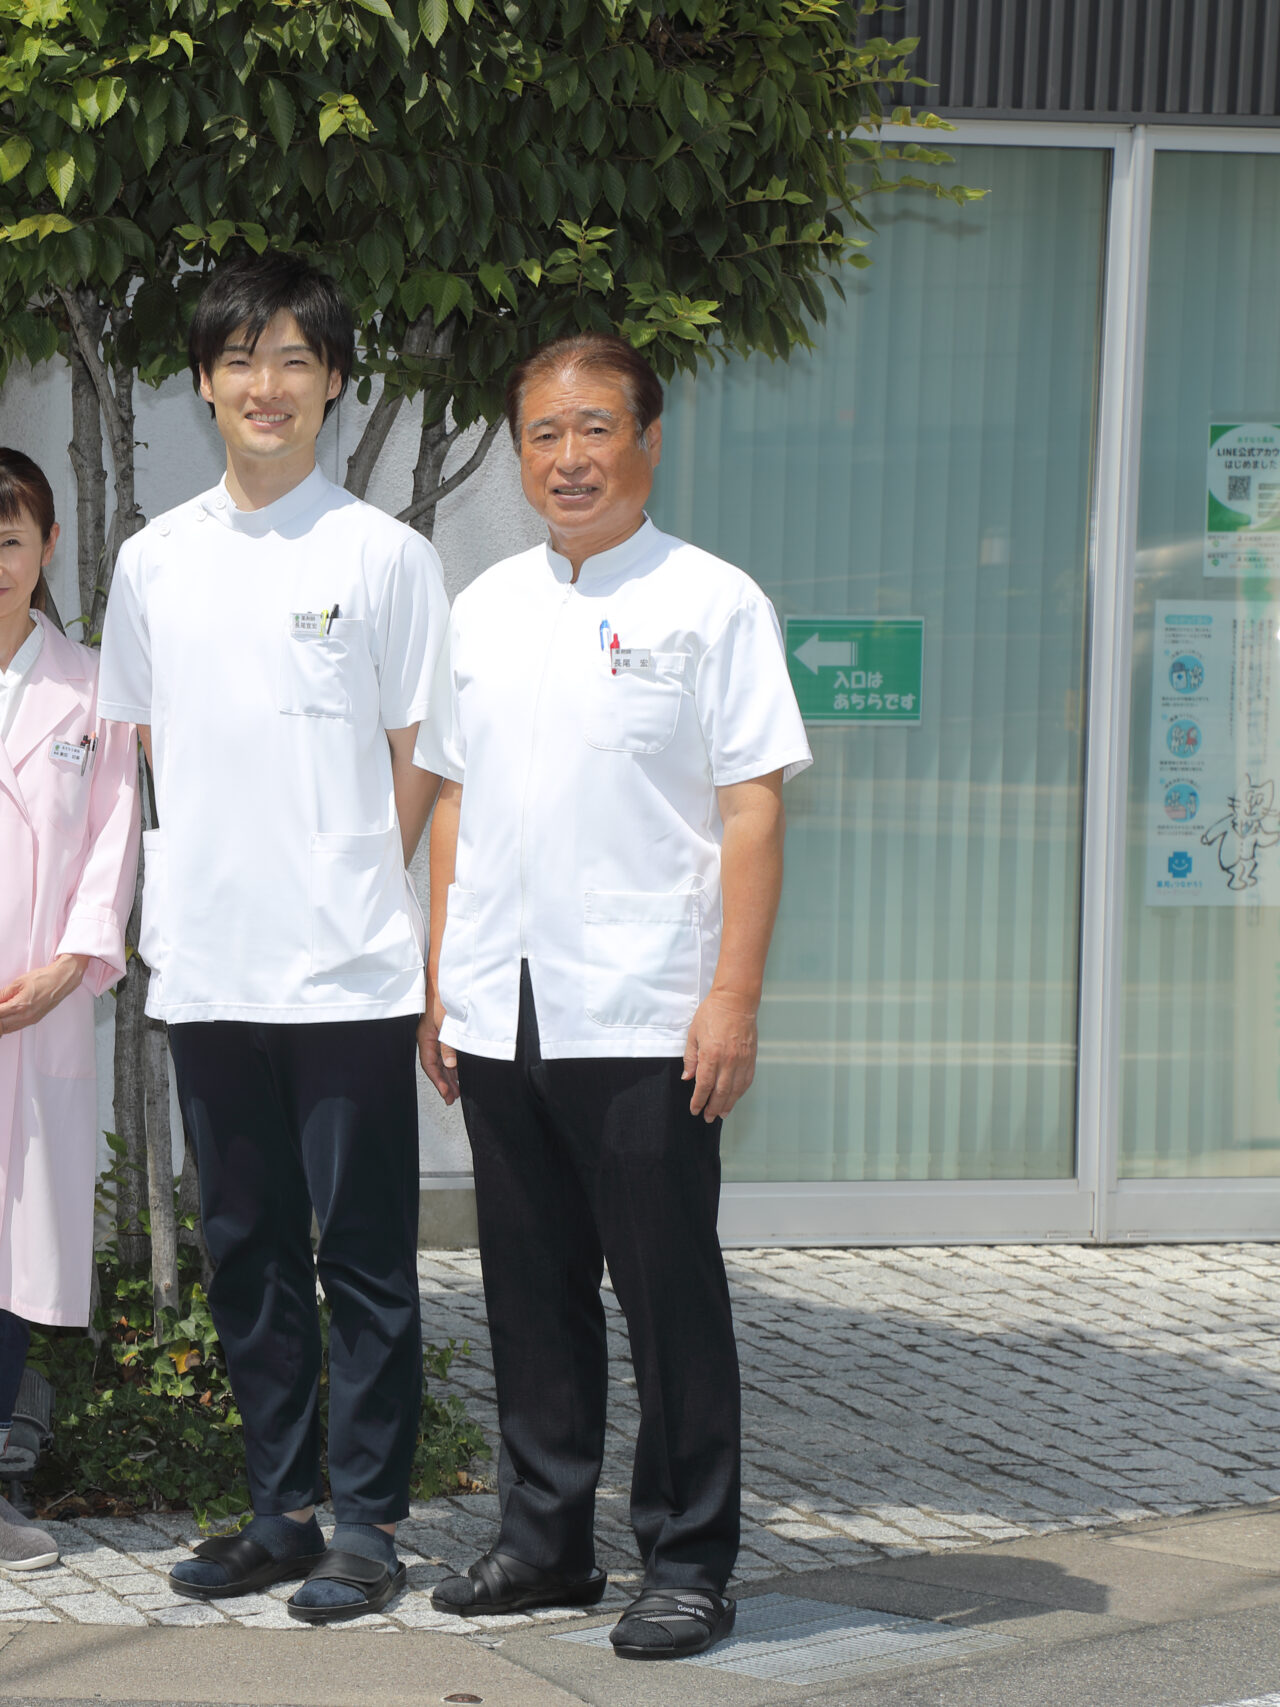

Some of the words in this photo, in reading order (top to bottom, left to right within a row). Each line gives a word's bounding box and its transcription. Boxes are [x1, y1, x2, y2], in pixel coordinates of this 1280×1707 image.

[1224, 460, 1279, 469] はじめました
[833, 671, 883, 689] 入口は
[833, 693, 917, 711] あちらです
